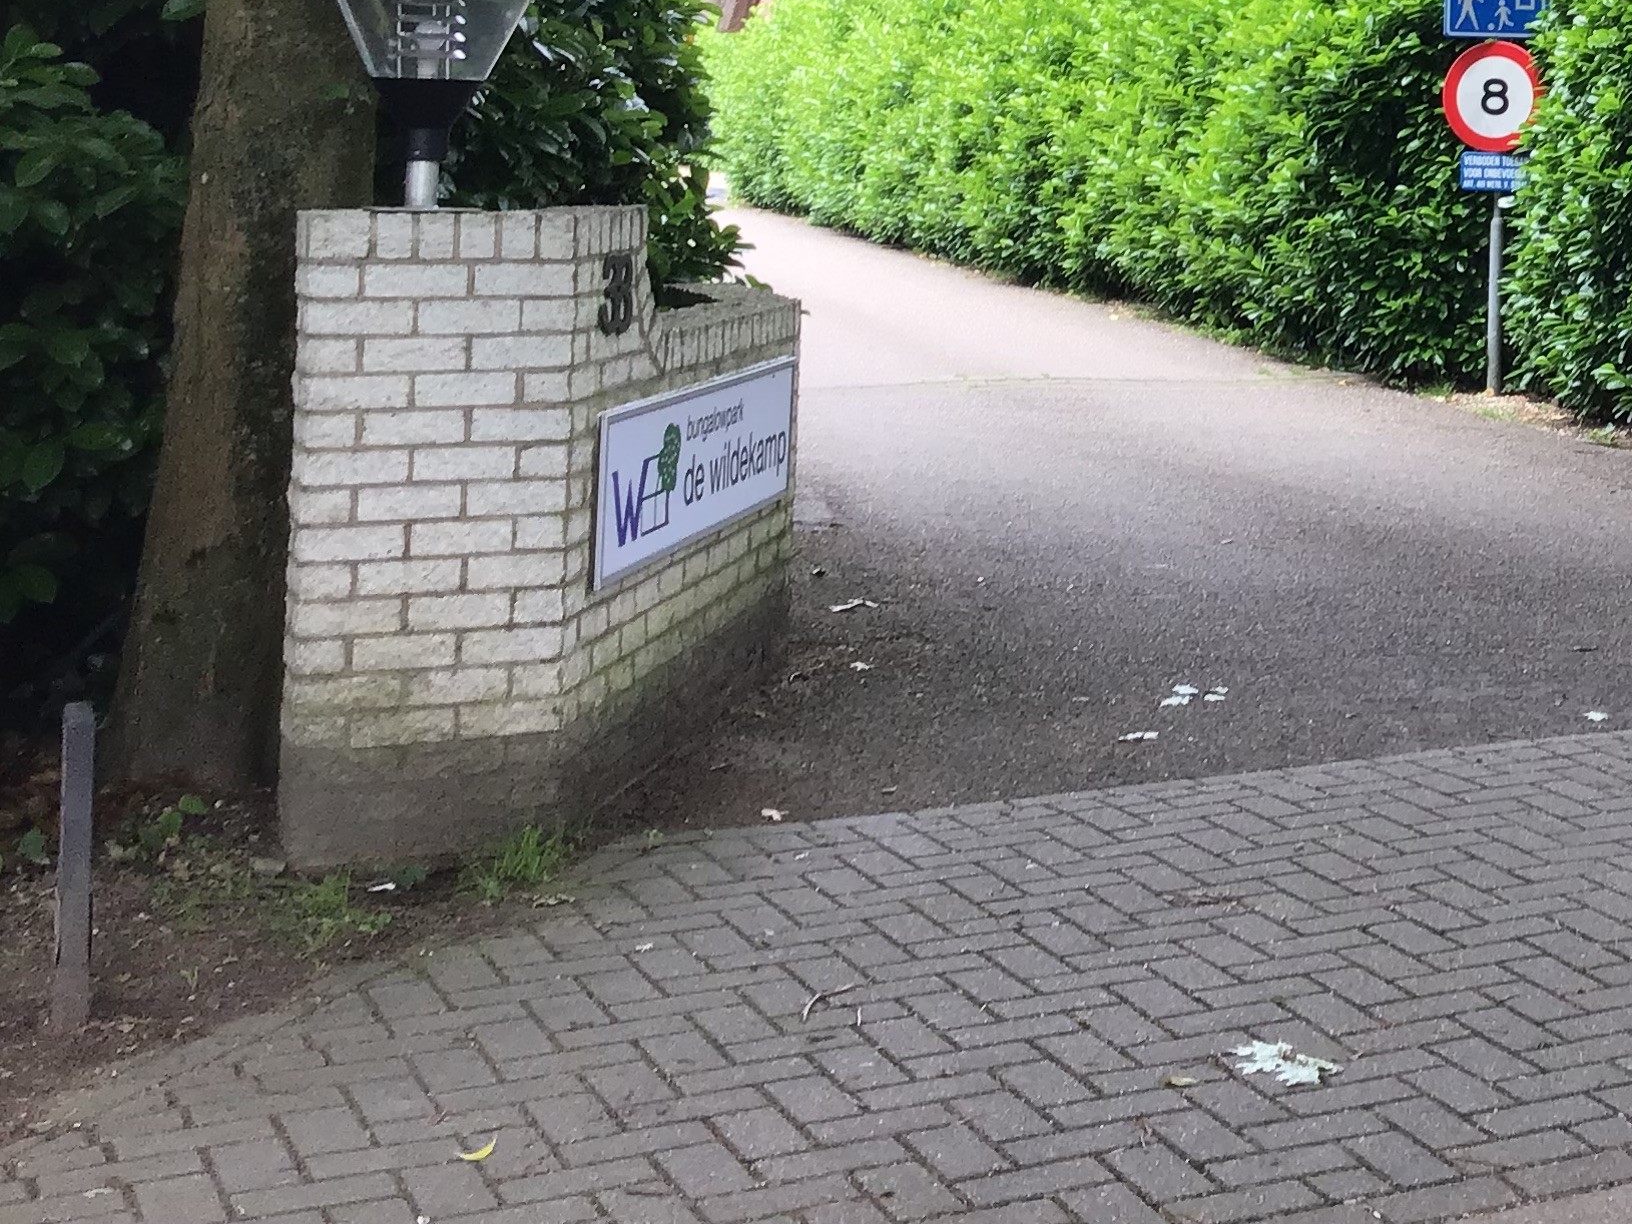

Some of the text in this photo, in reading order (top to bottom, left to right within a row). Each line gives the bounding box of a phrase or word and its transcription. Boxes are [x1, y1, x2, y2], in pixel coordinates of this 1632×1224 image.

[1481, 78, 1509, 116] 8
[1463, 167, 1482, 178] VOOR
[598, 253, 633, 337] 38
[686, 397, 744, 443] bungalowpark
[683, 430, 787, 506] de wildekamp
